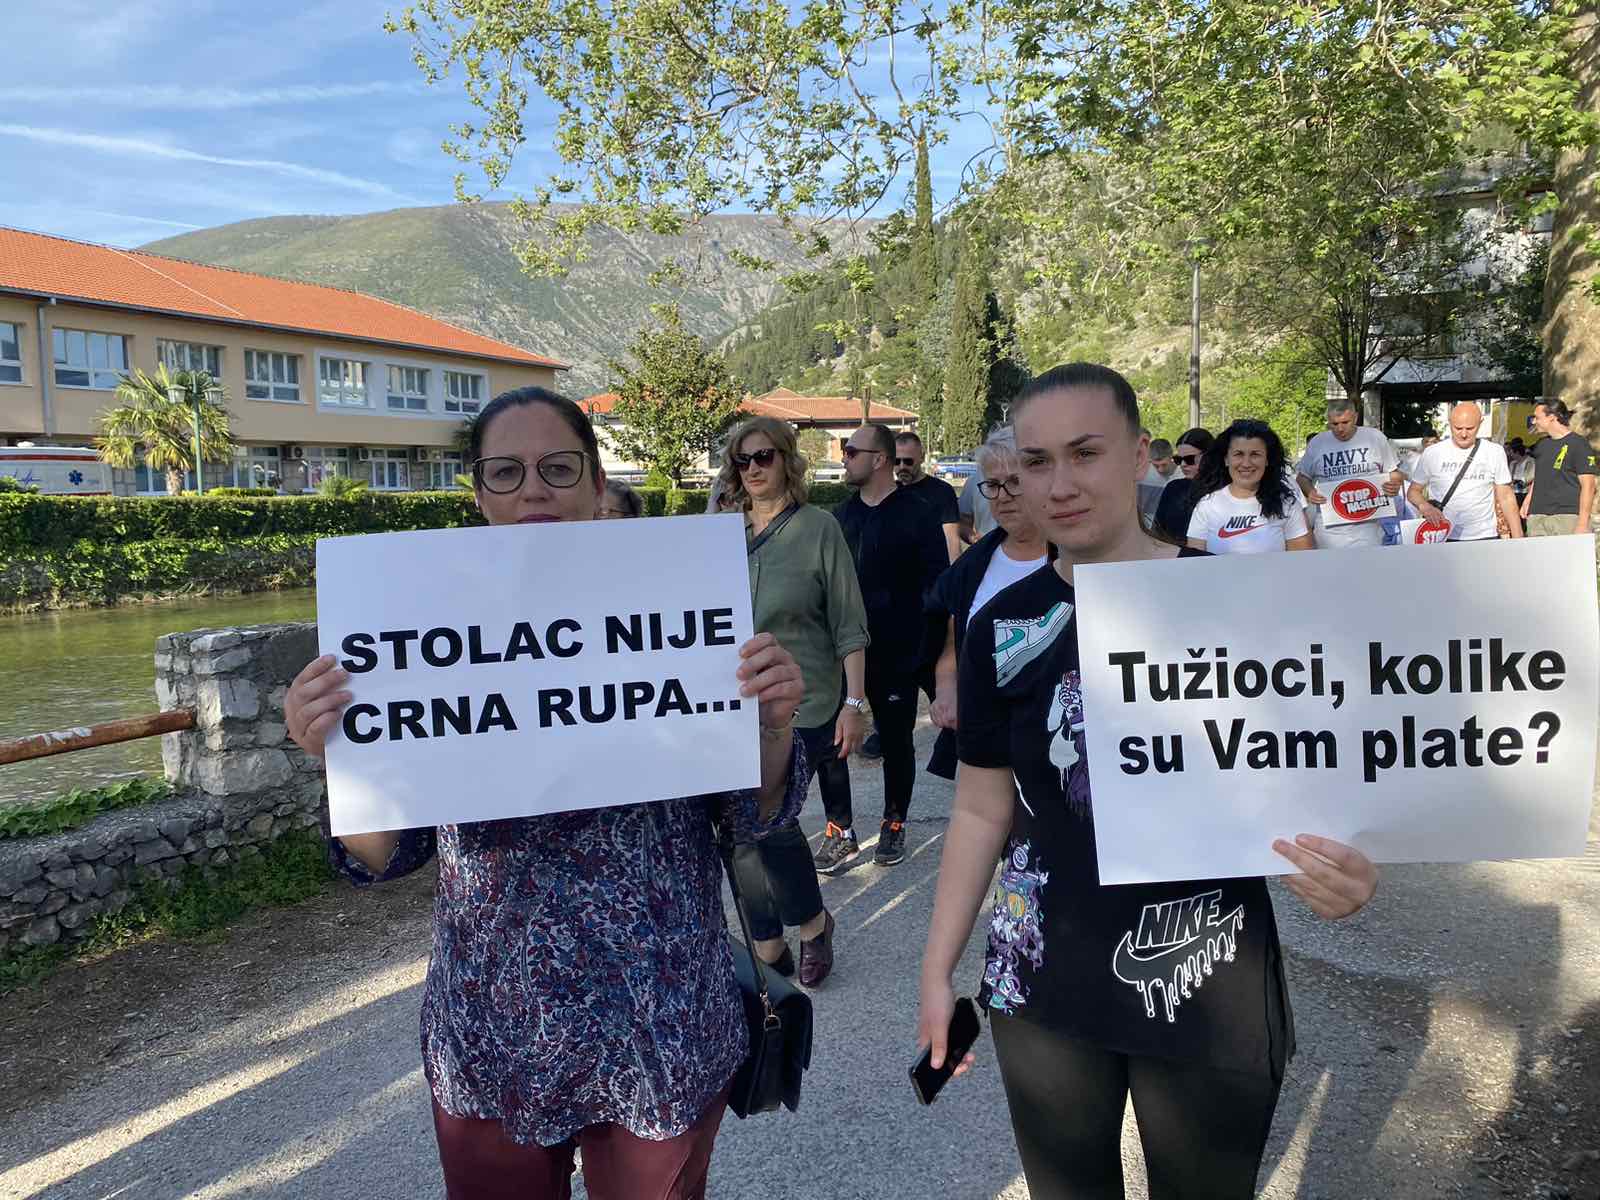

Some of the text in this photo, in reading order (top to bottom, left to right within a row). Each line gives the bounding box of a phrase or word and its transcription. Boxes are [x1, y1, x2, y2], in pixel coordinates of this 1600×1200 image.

[1322, 447, 1369, 468] NAVY
[1225, 515, 1258, 529] NIKE
[1339, 487, 1371, 504] STOP
[340, 607, 736, 674] STOLAC NIJE
[1107, 637, 1567, 710] Tužioci, kolike
[342, 678, 742, 744] CRNA RUPA...
[1118, 710, 1562, 783] su Vam plate?
[1135, 888, 1223, 949] NIKE
